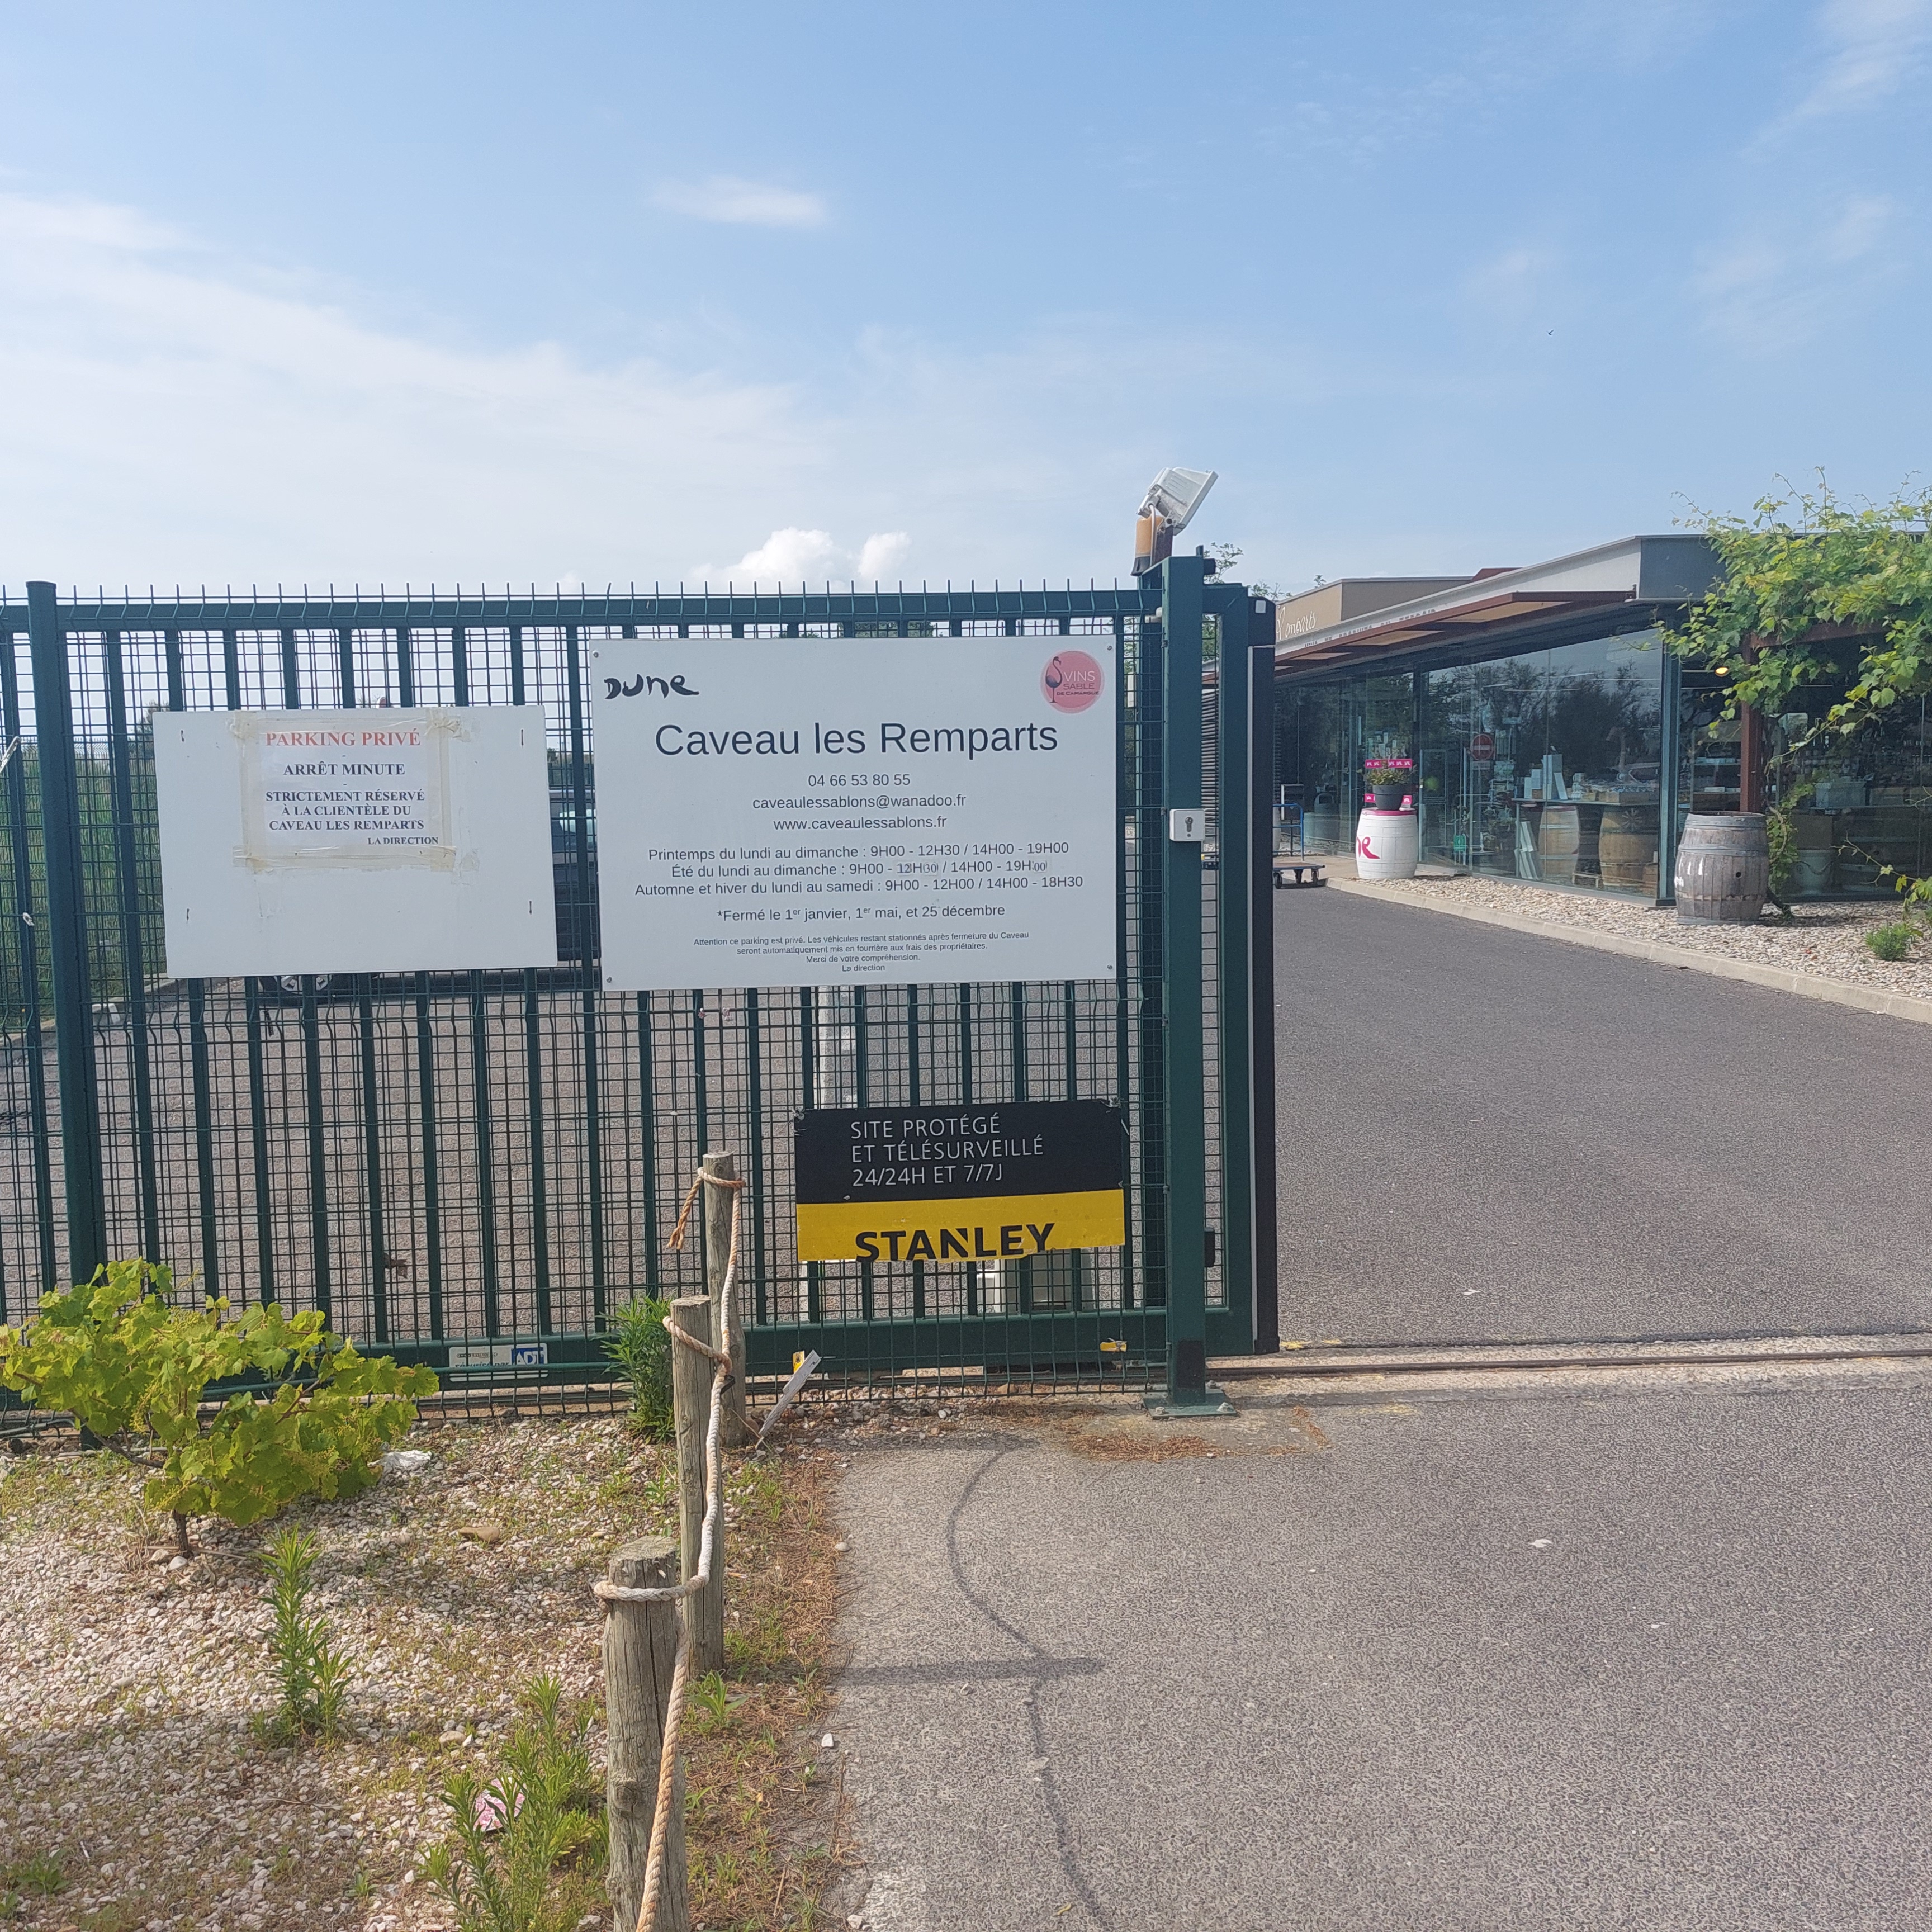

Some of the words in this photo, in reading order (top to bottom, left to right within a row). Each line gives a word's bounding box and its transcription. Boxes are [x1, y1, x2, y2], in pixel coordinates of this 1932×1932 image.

[1276, 606, 1318, 640] Remparts
[1063, 671, 1095, 681] VINS
[267, 732, 356, 746] PARKING
[362, 728, 421, 746] PRIVÉ
[656, 724, 799, 755] Caveau
[815, 722, 866, 754] les
[881, 722, 1058, 760] Remparts
[283, 761, 338, 775] ARRÊT
[342, 764, 405, 775] MINUTE
[808, 775, 825, 787] 04
[830, 774, 846, 787] 66
[851, 774, 868, 786] 53
[873, 774, 889, 786] 80
[894, 774, 911, 785] 55
[266, 791, 362, 802] STRICTEMENT
[365, 788, 425, 801] RÉSERVÉ
[752, 793, 967, 809] caveaulessablons@wanadoo.fr
[281, 803, 291, 816] À
[293, 806, 312, 816] LA
[314, 803, 390, 816] CLIENTÈLE
[393, 806, 411, 815] DU
[269, 820, 322, 830] CAVEAU
[326, 820, 350, 830] LES
[353, 820, 424, 830] REMPARTS
[773, 815, 947, 830] www.caveaulessablons.fr
[648, 849, 716, 863] Printemps
[719, 847, 736, 860] du
[740, 847, 770, 859] lundi
[775, 850, 791, 859] au
[795, 846, 858, 859] dimanche
[870, 845, 905, 857] 9H00
[918, 844, 960, 856] 12H30
[972, 843, 1014, 855] 14H00
[1027, 842, 1069, 854] 19H00
[671, 864, 693, 878] Été
[698, 865, 714, 877] du
[718, 865, 749, 877] lundi
[754, 867, 769, 877] au
[774, 864, 837, 876] dimanche
[849, 863, 884, 875] 9H00
[951, 861, 993, 873] 14H00
[634, 884, 694, 896] Automne
[699, 884, 712, 894] et
[716, 882, 747, 894] hiver
[751, 882, 767, 893] du
[771, 881, 802, 893] lundi
[807, 883, 822, 893] au
[827, 879, 873, 892] samedi
[885, 879, 920, 891] 9H00
[933, 878, 974, 890] 12H00
[987, 877, 1029, 889] 14H00
[1041, 876, 1083, 888] 18H30
[770, 908, 781, 920] le
[804, 908, 851, 922] janvier,
[875, 906, 901, 920] mai,
[906, 907, 918, 917] et
[922, 906, 937, 917] 25
[941, 905, 1005, 917] décembre
[693, 937, 727, 946] Attention
[741, 937, 769, 946] parking
[928, 933, 950, 942] après
[763, 946, 828, 955] automatiquement
[830, 945, 844, 953] mis
[856, 944, 888, 952] fourrière
[939, 942, 987, 952] propriétaires.
[861, 953, 921, 963] compréhension.
[851, 1120, 893, 1139] SITE
[903, 1112, 1000, 1137] PROTÉGÉ
[852, 1145, 875, 1163] ET
[883, 1134, 1043, 1162] TÉLÉSURVEILLÉ
[853, 1167, 925, 1186] 24/24H
[934, 1166, 956, 1183] ET
[963, 1163, 1002, 1182] 7/7J
[855, 1223, 1055, 1262] STANLEY
